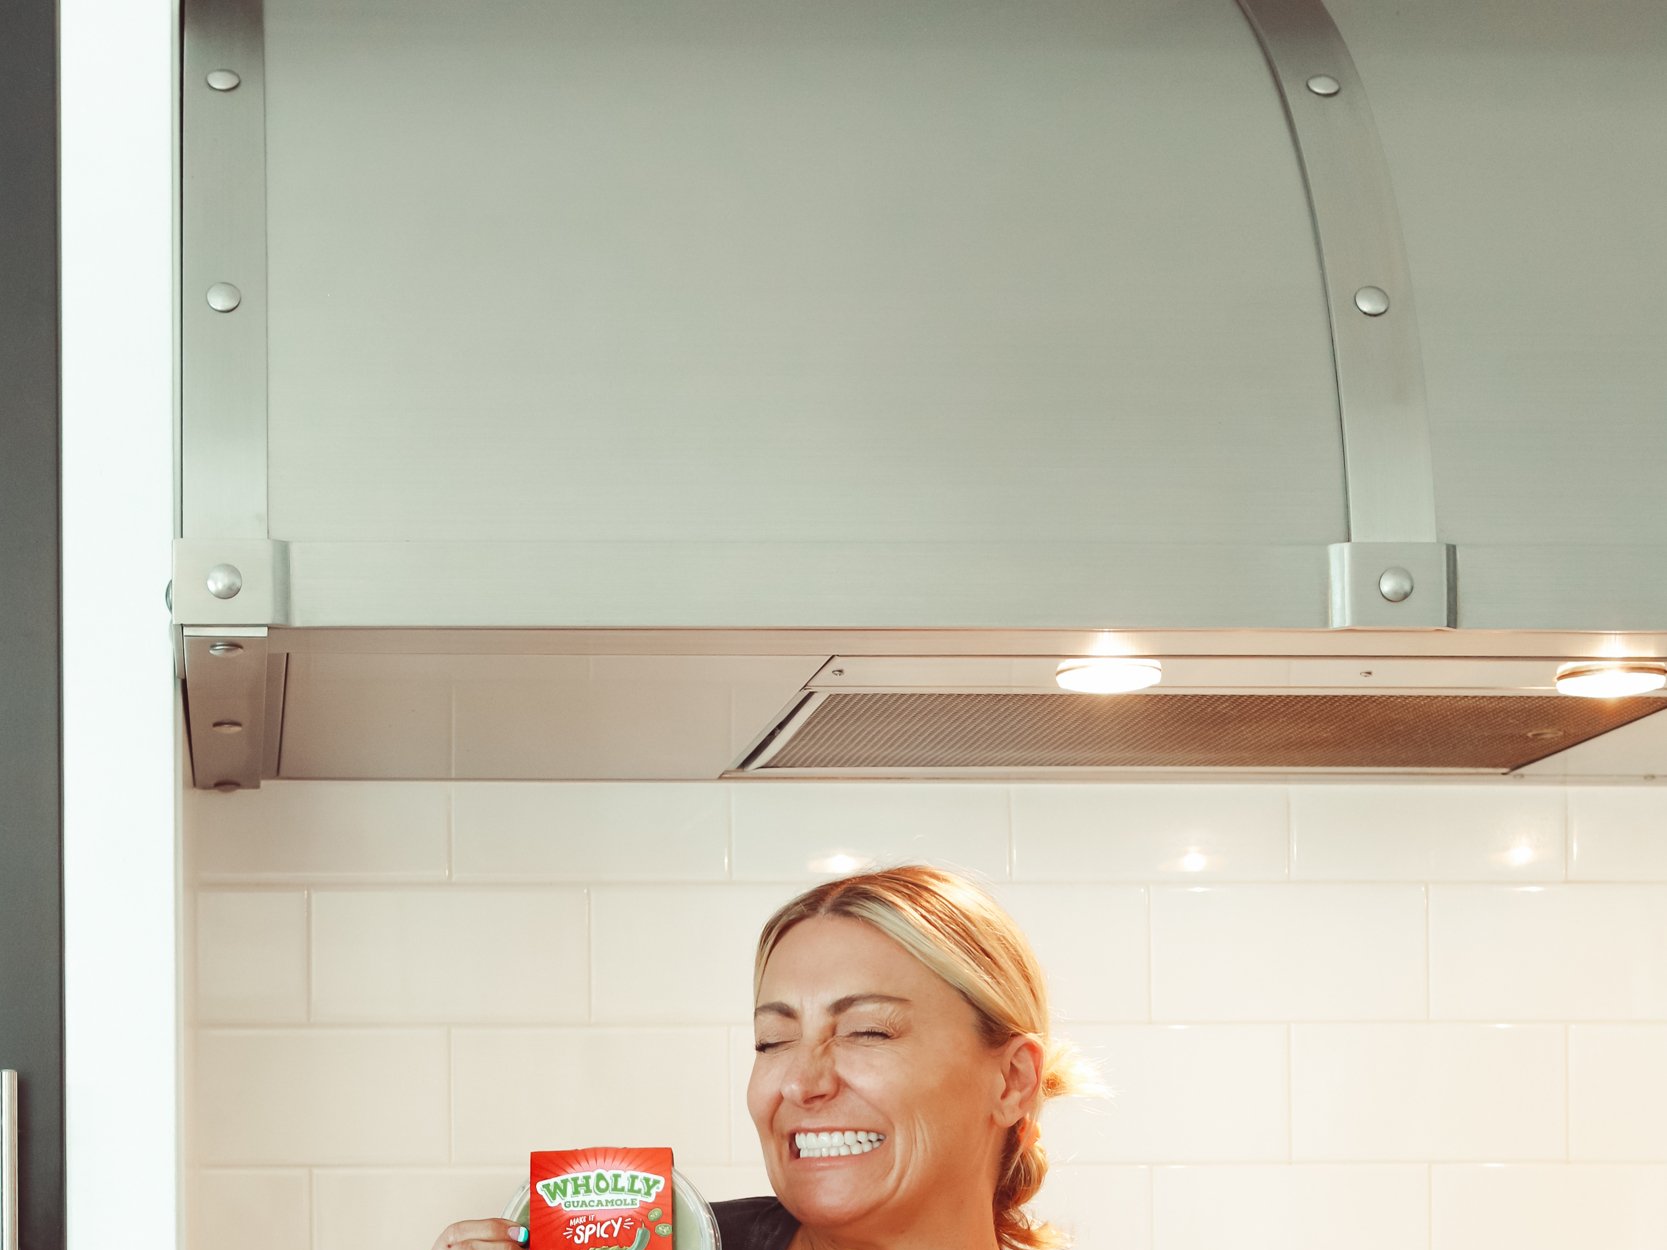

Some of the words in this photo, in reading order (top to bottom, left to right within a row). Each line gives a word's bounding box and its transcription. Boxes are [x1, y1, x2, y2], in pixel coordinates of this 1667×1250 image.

[541, 1172, 661, 1202] WHOLLY
[564, 1198, 638, 1209] GUACAMOLE
[570, 1216, 587, 1226] MAKE
[573, 1217, 622, 1244] SPICY
